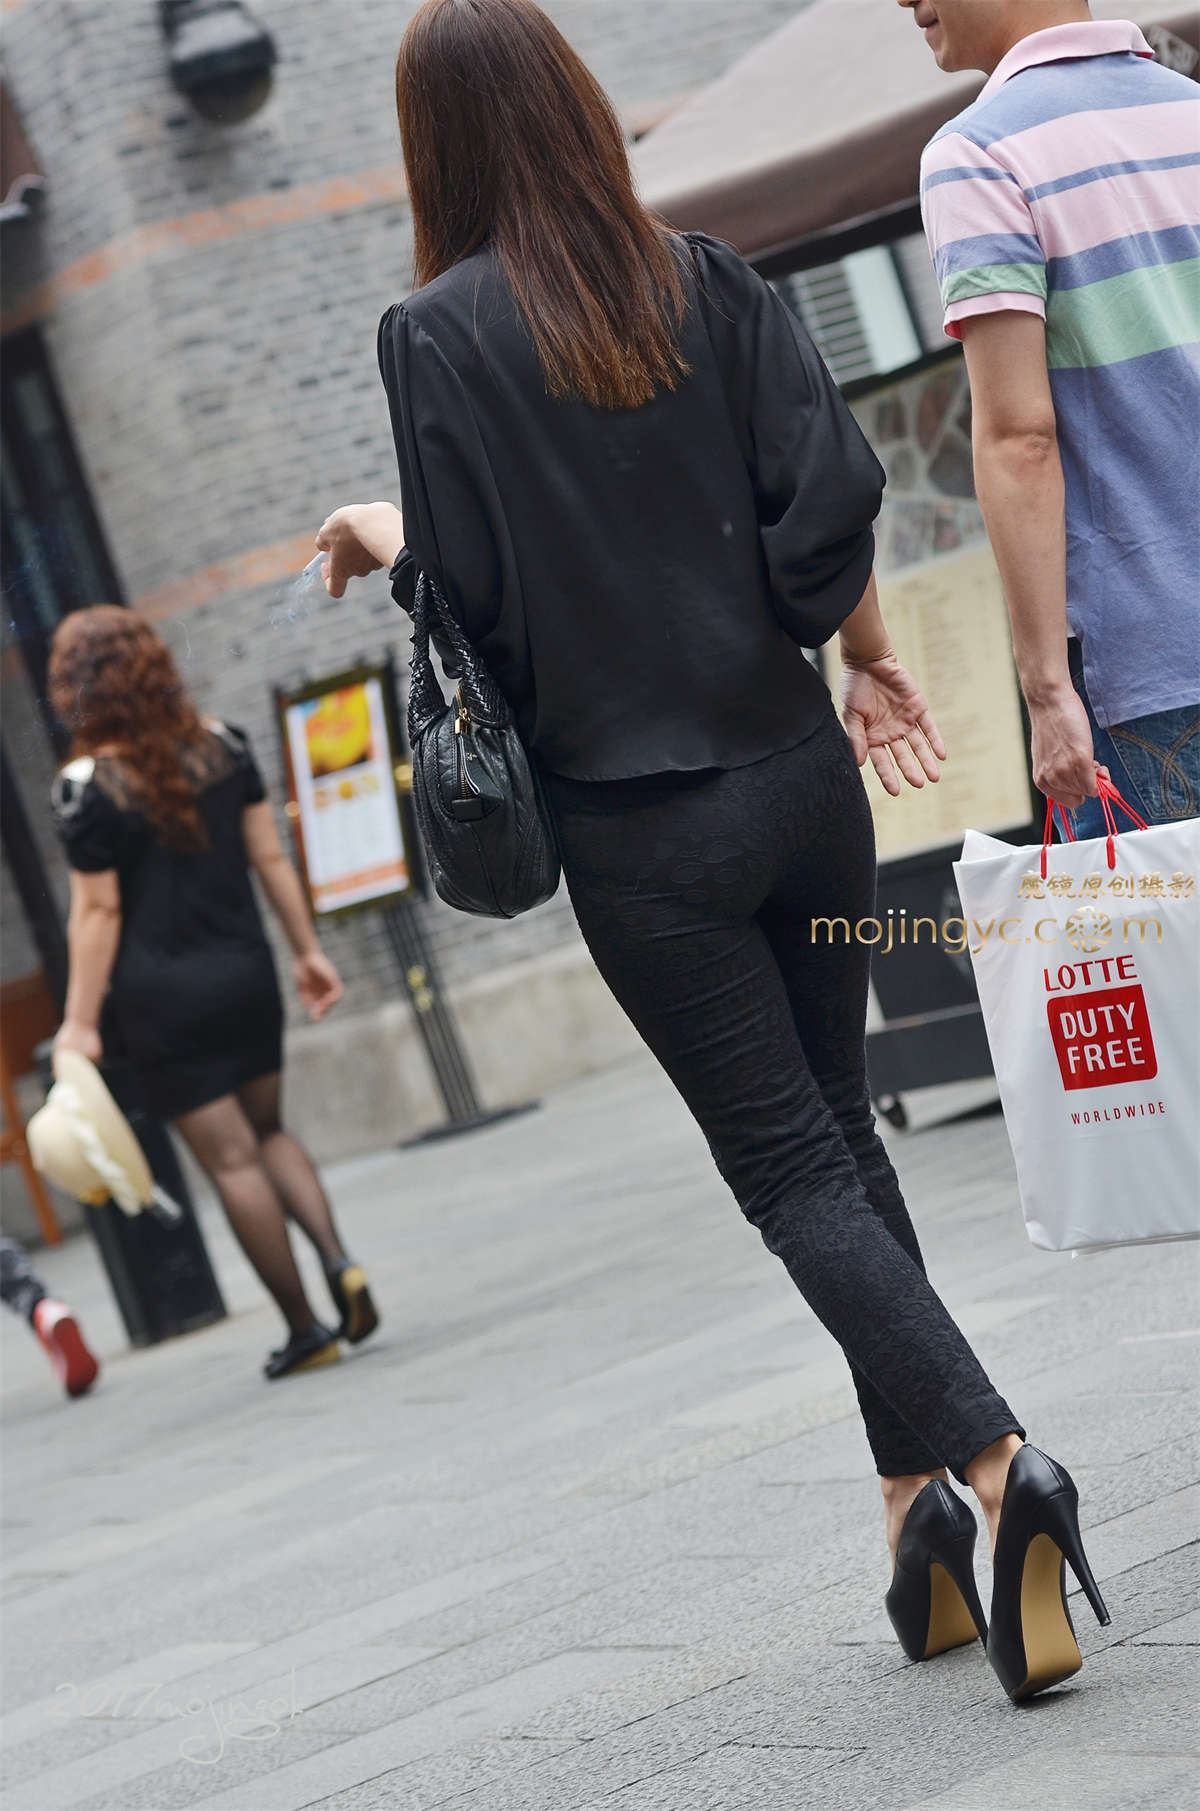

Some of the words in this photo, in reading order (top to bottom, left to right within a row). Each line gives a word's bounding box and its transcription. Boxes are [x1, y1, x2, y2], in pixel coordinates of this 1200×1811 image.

[1043, 954, 1138, 992] LOTTE
[1059, 1001, 1136, 1040] DUTY
[1066, 1036, 1146, 1075] FREE
[1071, 1101, 1166, 1125] WORLDWIDE
